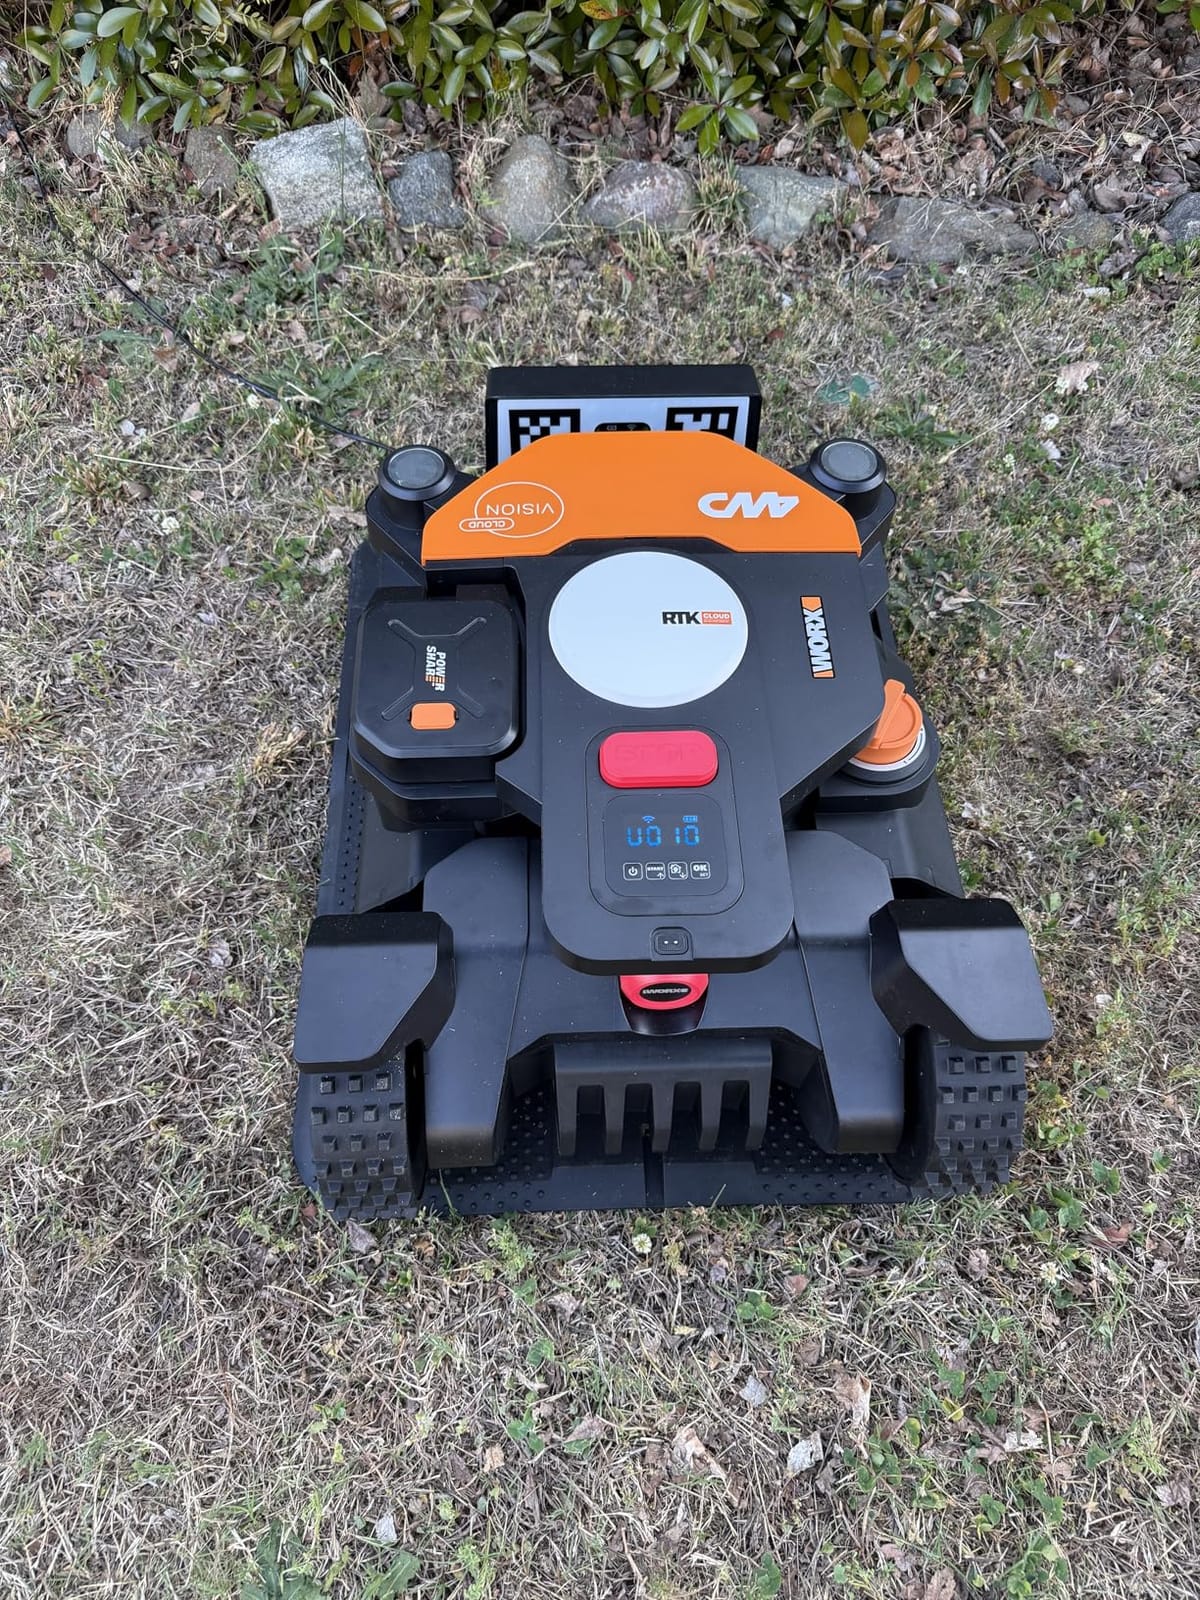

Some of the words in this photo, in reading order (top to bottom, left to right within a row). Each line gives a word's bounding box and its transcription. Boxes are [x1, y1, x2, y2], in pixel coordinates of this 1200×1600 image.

[485, 503, 555, 516] VISION
[698, 491, 800, 519] 4WD
[468, 520, 506, 530] CLOUD
[662, 611, 701, 624] RTK
[802, 608, 833, 673] WORX
[425, 645, 436, 682] SHARE
[435, 651, 446, 692] POWER
